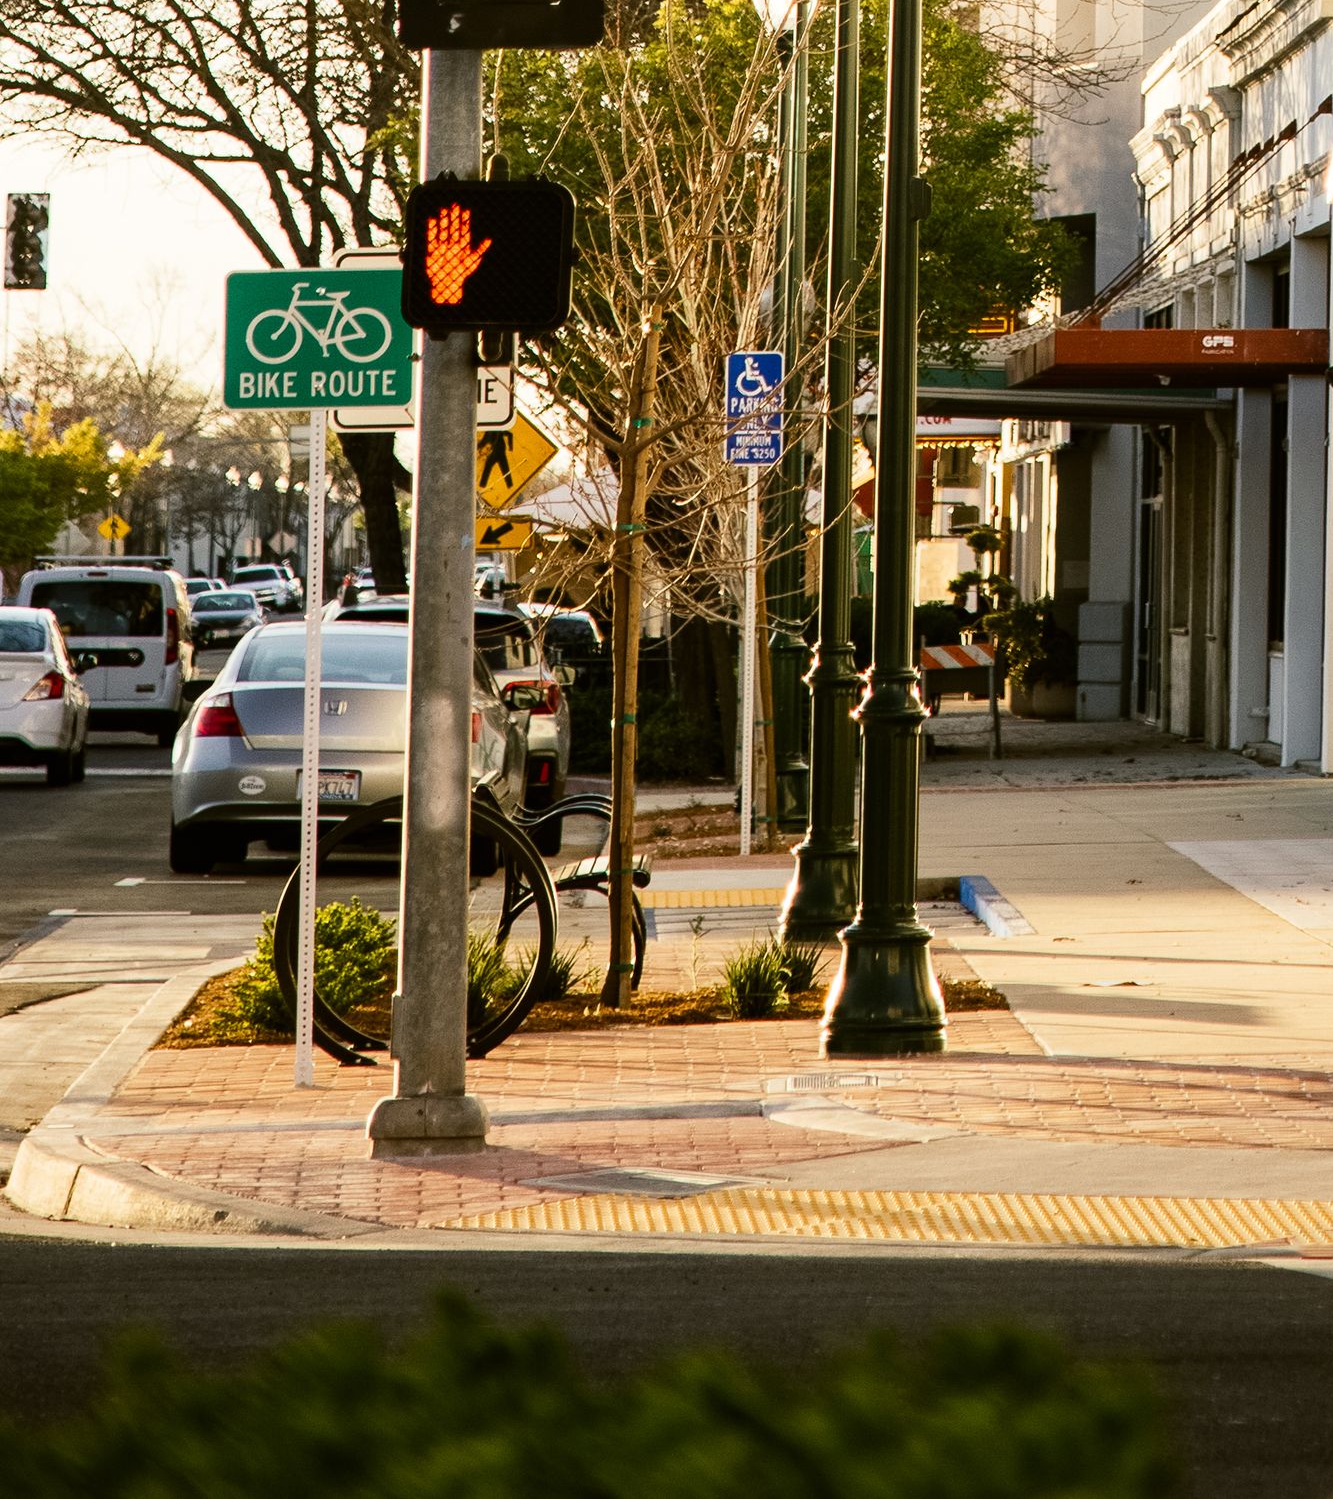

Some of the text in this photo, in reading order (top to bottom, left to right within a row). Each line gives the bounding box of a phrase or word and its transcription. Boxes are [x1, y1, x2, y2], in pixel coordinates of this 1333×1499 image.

[239, 369, 397, 398] BIKE ROUTE
[735, 435, 772, 447] MINIMUM
[730, 447, 750, 460] FINE
